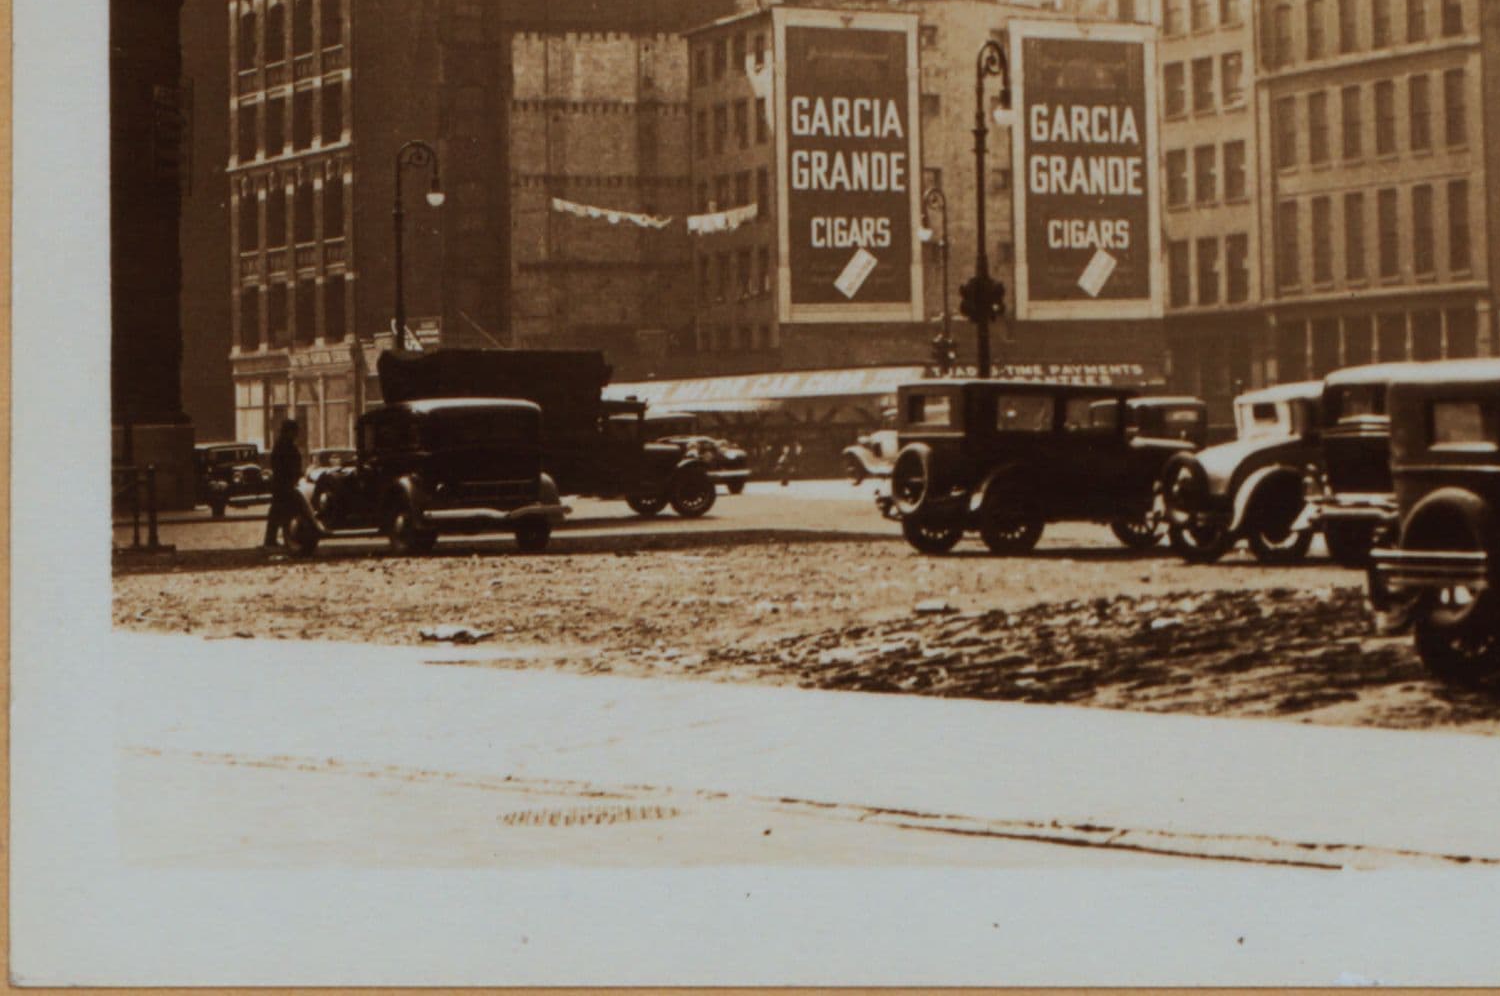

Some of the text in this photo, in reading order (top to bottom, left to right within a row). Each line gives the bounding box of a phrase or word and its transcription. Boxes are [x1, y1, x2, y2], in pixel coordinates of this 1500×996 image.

[791, 96, 904, 138] GARCIA
[1030, 105, 1139, 144] GARCIA
[791, 150, 906, 192] GRANDE
[1030, 156, 1143, 195] GRANDE
[811, 217, 891, 248] CIGARS
[1048, 219, 1130, 249] CIGARS
[1049, 363, 1145, 376] PAYMENTS
